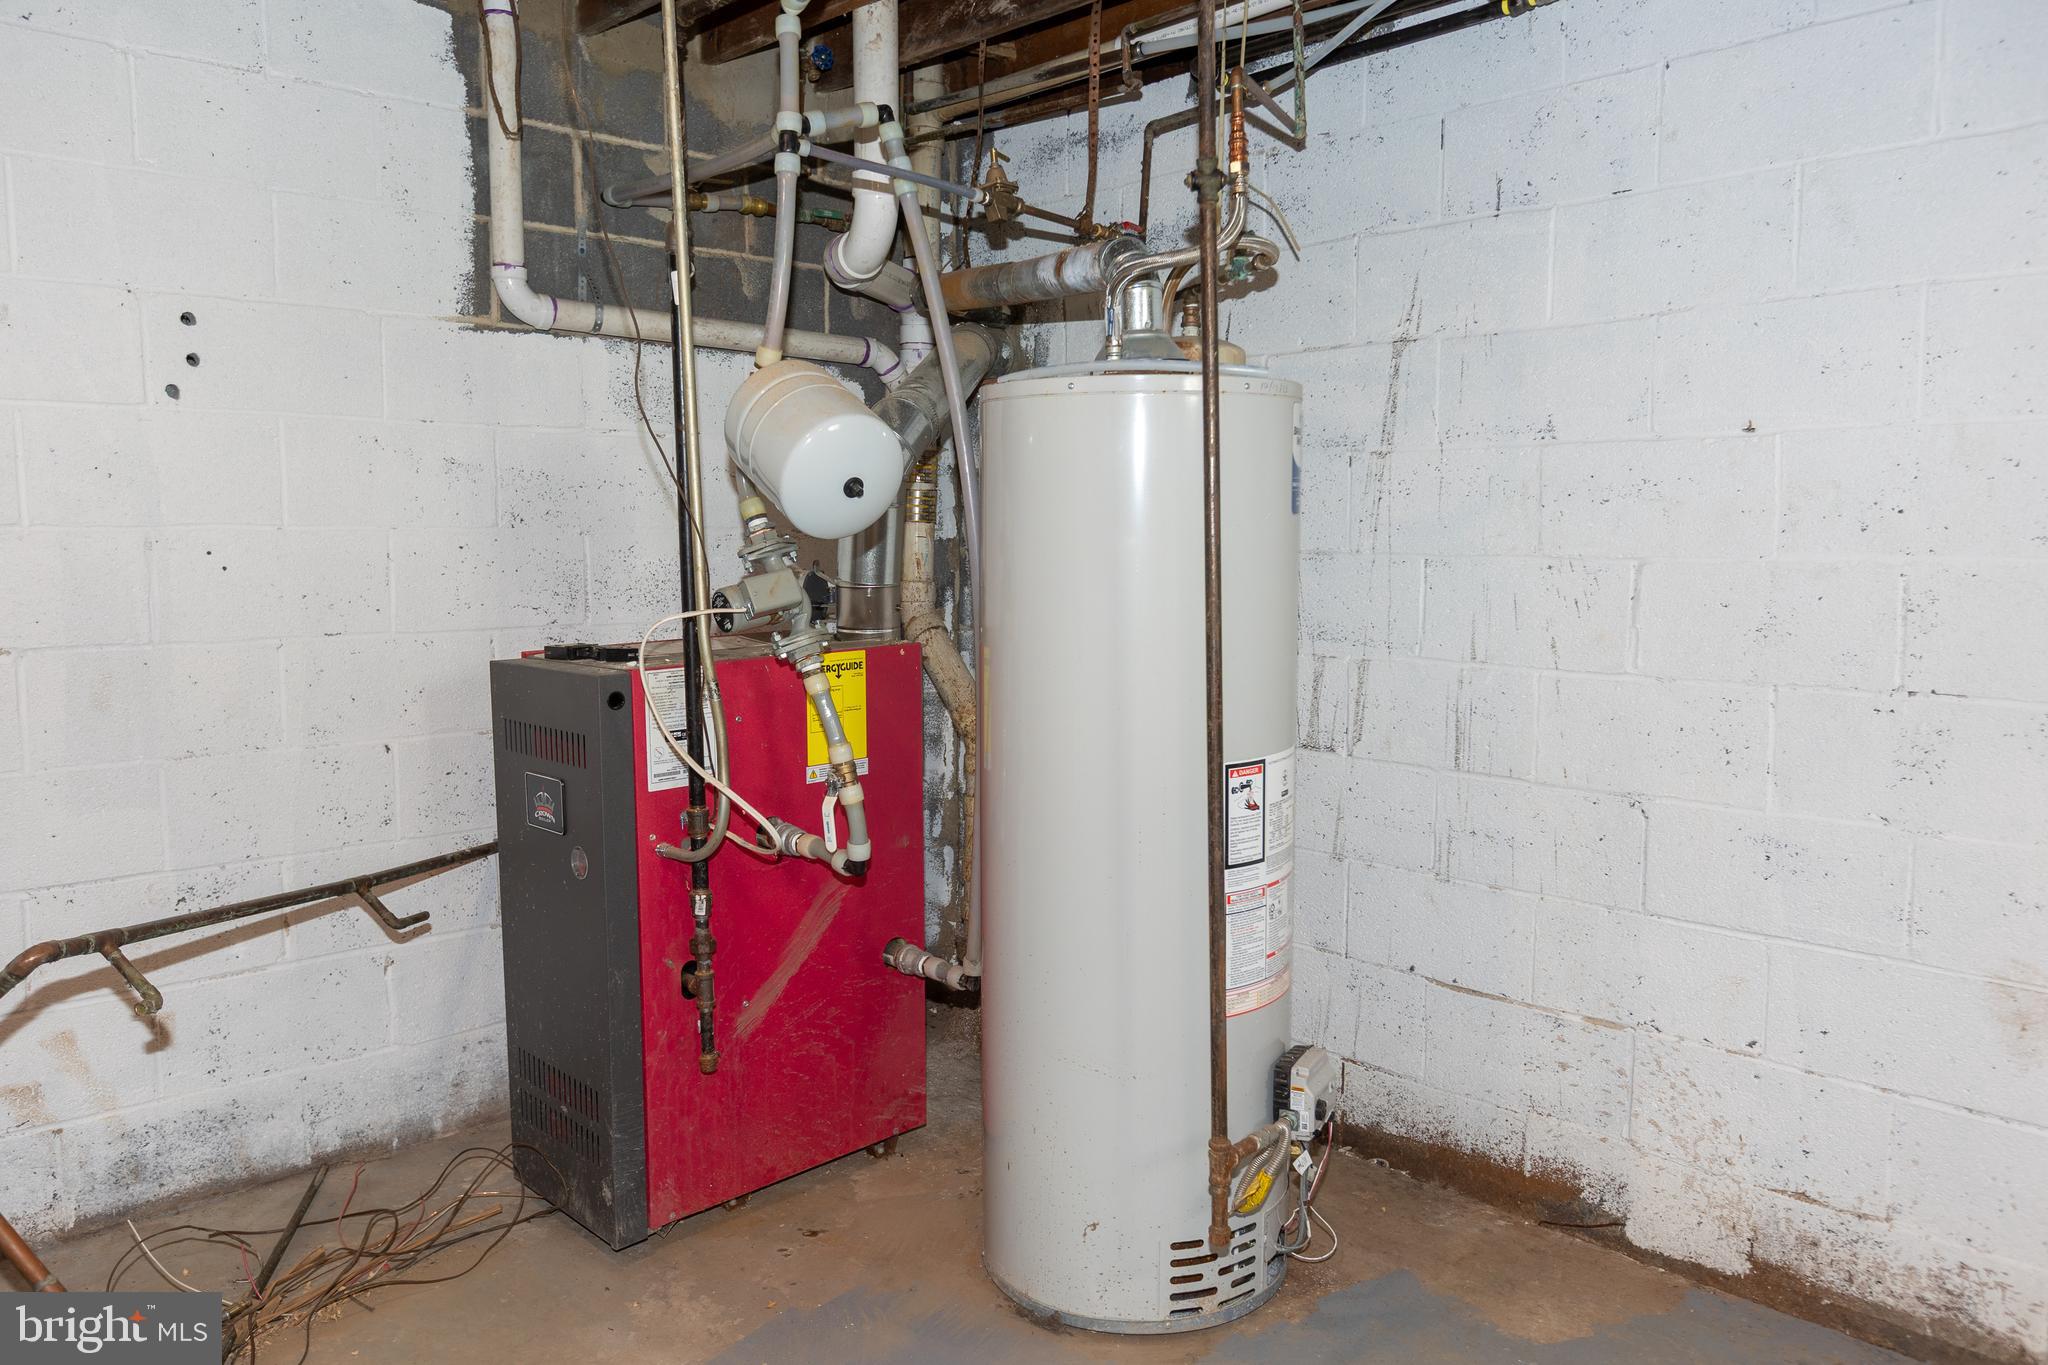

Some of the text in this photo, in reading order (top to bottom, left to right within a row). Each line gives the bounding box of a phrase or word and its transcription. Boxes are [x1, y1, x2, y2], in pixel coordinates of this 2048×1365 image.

[821, 661, 864, 674] ERGYGUIDE
[1238, 767, 1259, 776] DANGER
[535, 811, 555, 824] CROWN
